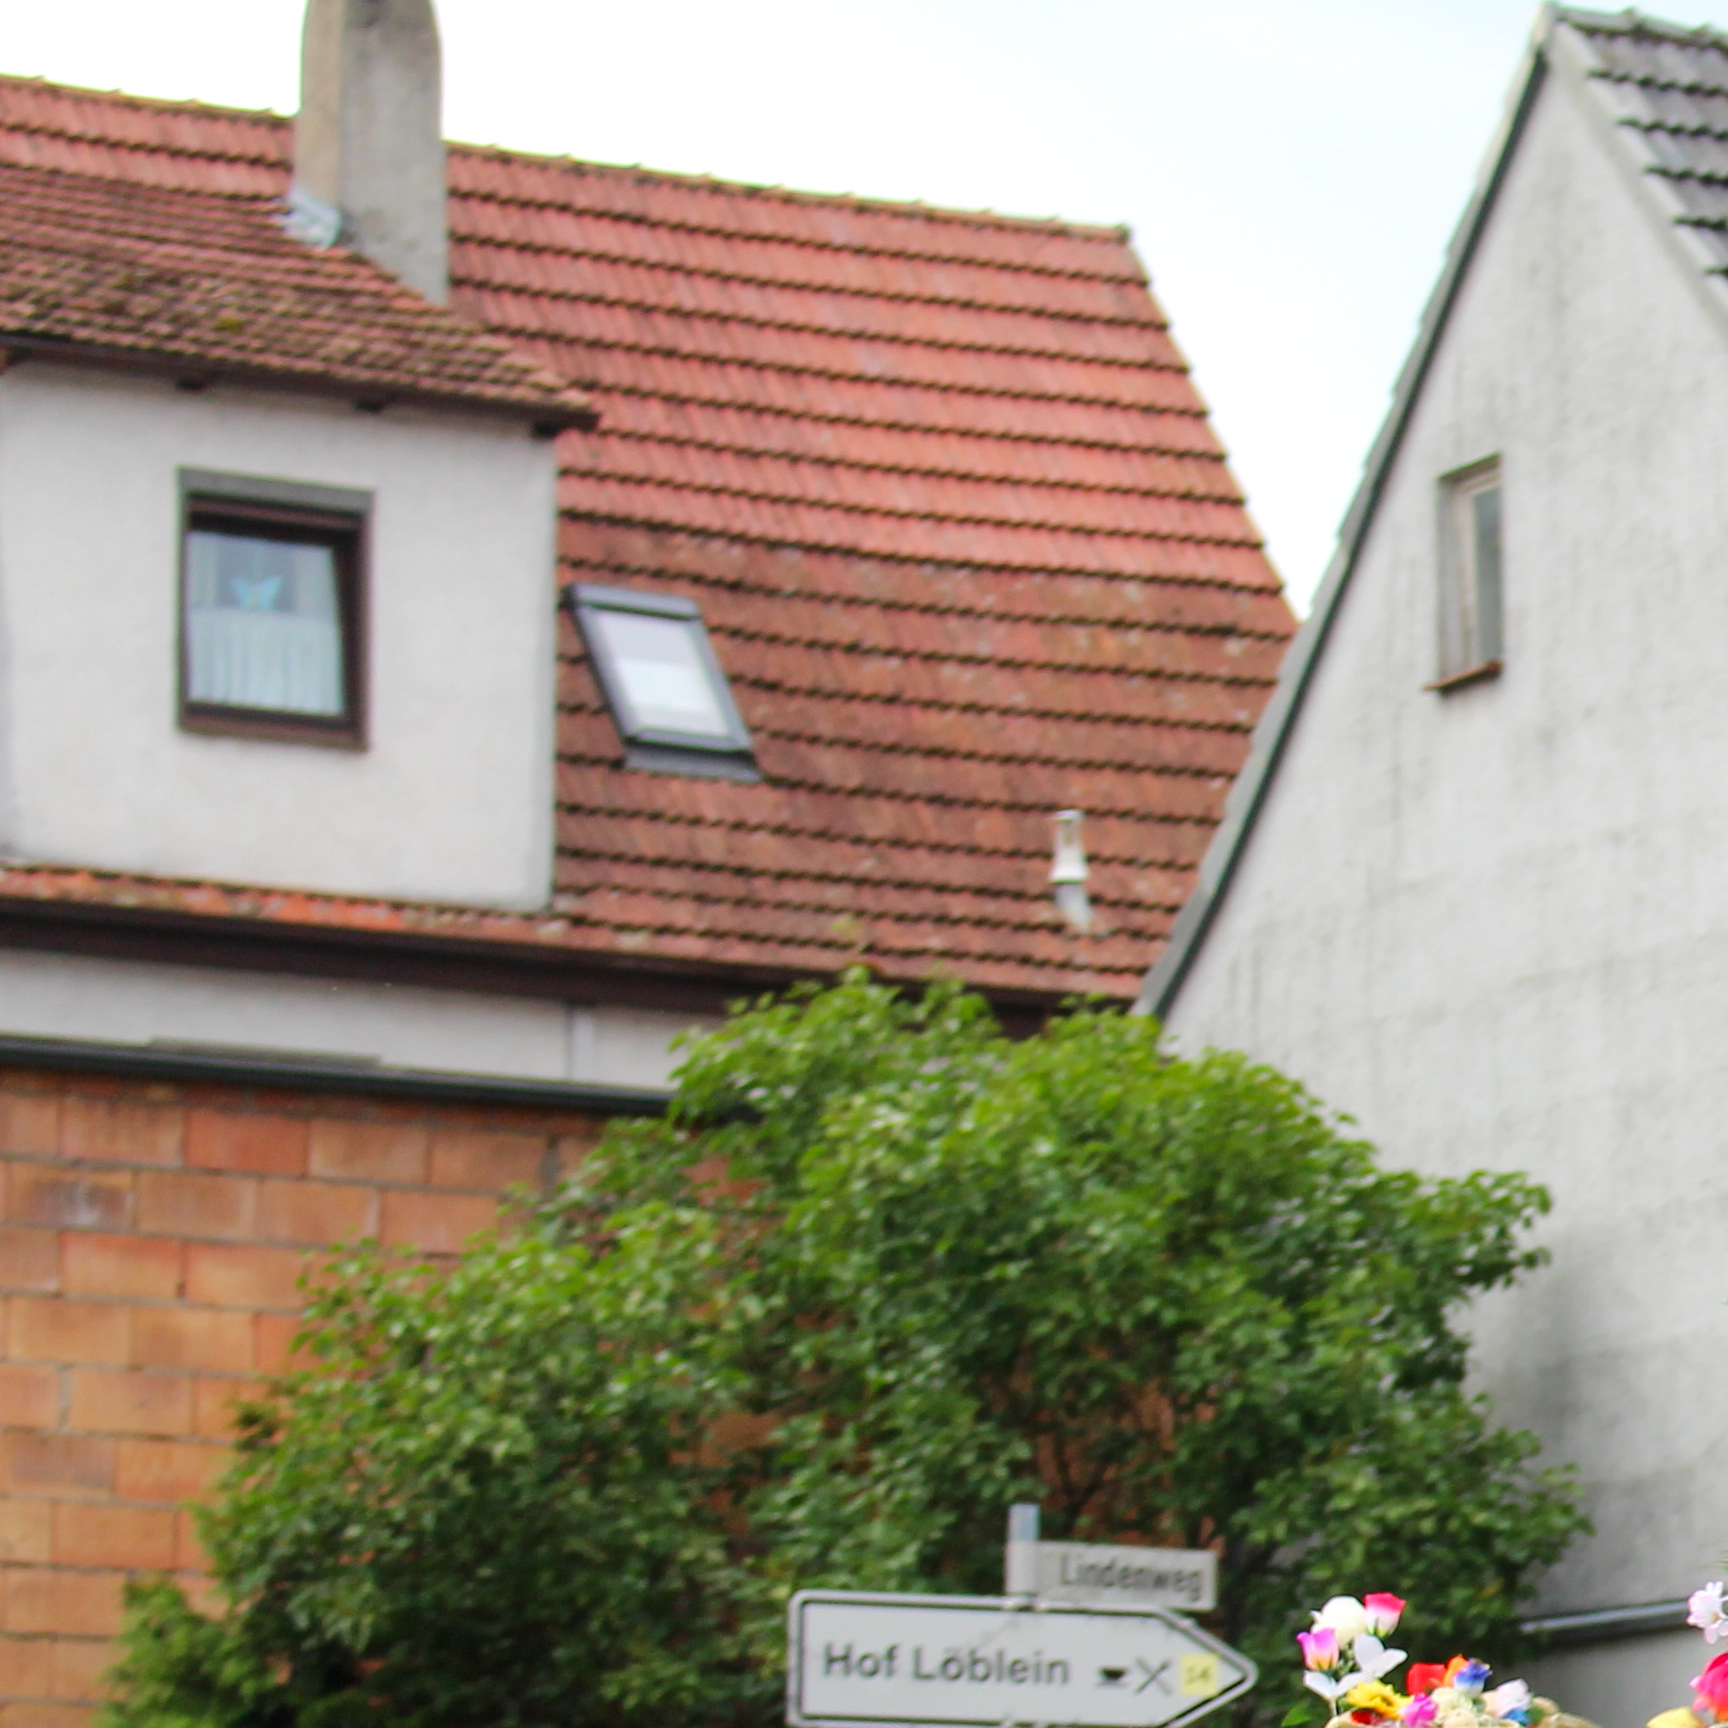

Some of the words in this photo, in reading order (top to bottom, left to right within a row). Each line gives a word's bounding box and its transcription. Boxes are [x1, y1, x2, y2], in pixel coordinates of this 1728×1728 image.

[1060, 1554, 1202, 1603] Lindenweg
[824, 1643, 898, 1677] Hof
[913, 1645, 1069, 1684] Löblein
